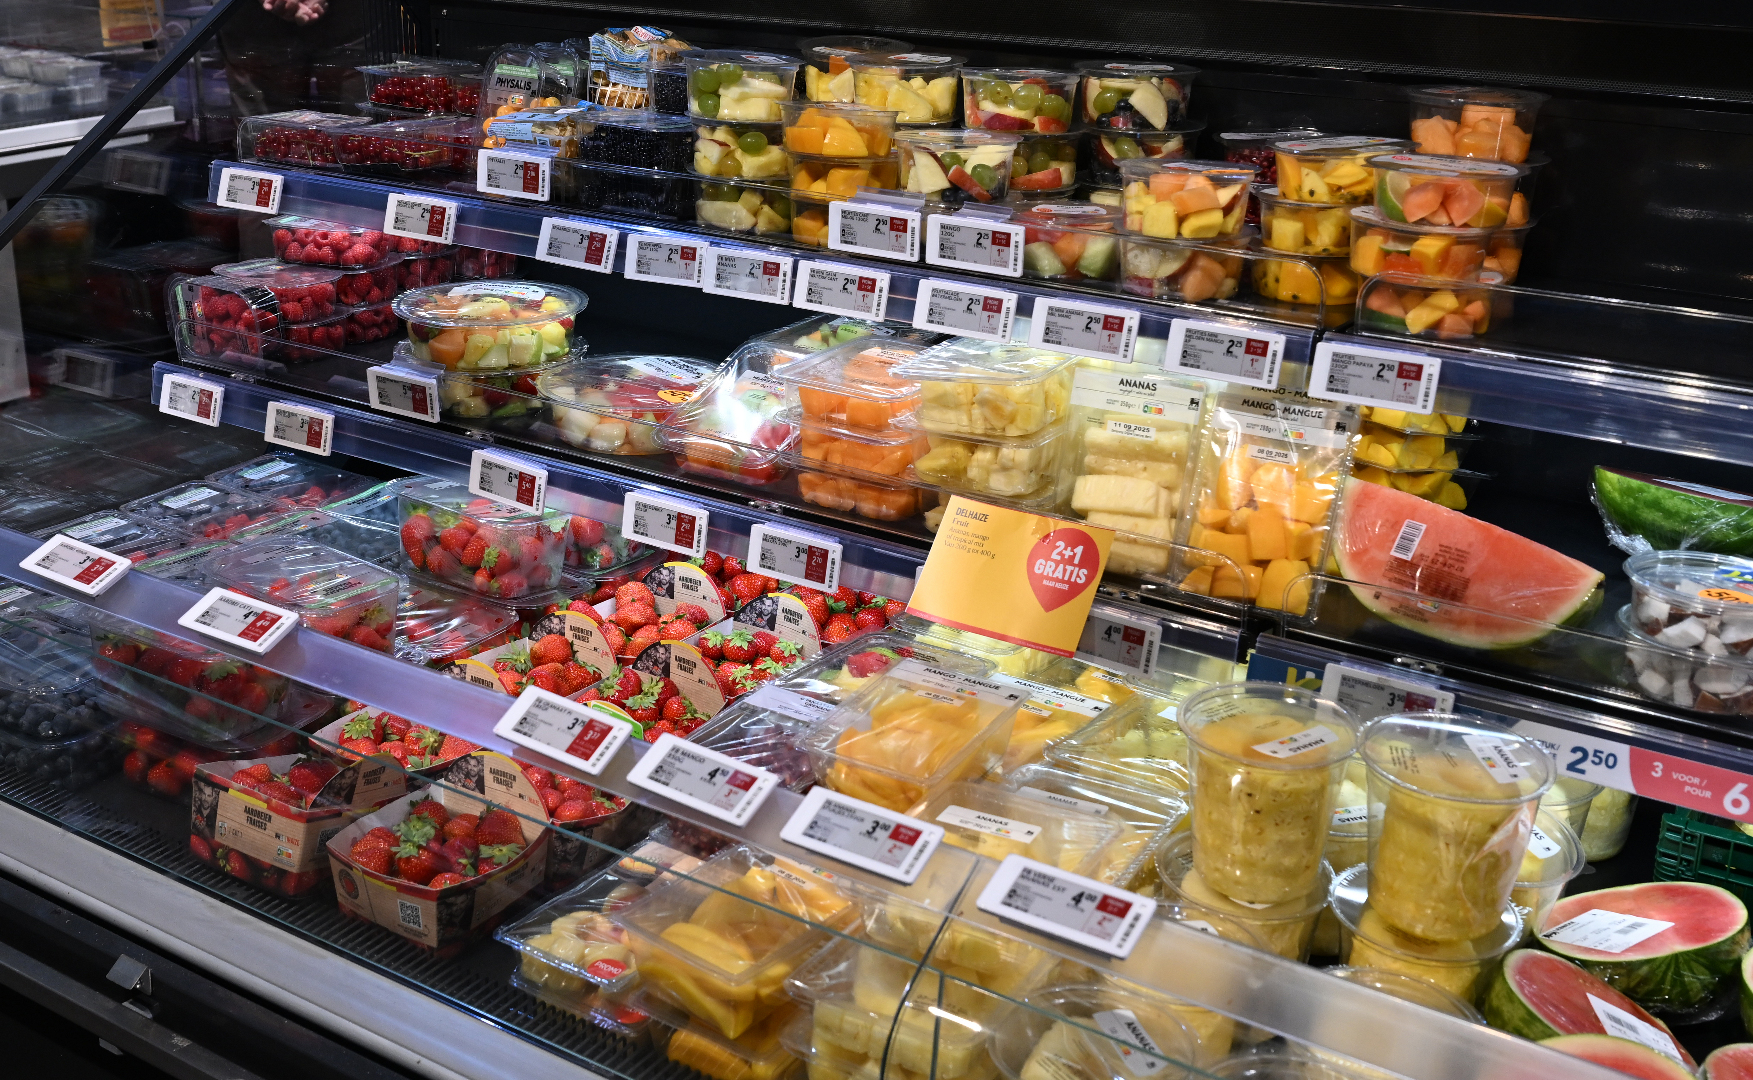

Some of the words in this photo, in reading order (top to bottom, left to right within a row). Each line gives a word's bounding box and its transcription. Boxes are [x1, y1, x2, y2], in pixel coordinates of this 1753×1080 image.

[495, 77, 532, 90] PHYSALIS
[1118, 378, 1158, 392] ANANAS
[1241, 398, 1276, 411] MANGO
[1283, 405, 1324, 419] MANGUE
[1133, 425, 1151, 433] 2025
[1274, 451, 1289, 459] 2025
[952, 516, 970, 528] Fruit
[955, 507, 989, 523] DELHAIZE
[953, 533, 973, 546] tropical
[970, 530, 990, 542] mango
[954, 541, 967, 551] 200
[980, 548, 991, 557] 400
[1051, 540, 1084, 565] 2+1
[1034, 558, 1088, 584] GRATIS
[678, 575, 702, 587] AARDBEIEN
[681, 582, 699, 593] FRAISES
[783, 614, 800, 626] FRAISES
[569, 624, 593, 638] AARDBEIEN
[572, 632, 590, 643] FRAISES
[674, 654, 697, 669] AARDBEIEN
[677, 662, 694, 675] FRAISES
[470, 674, 494, 689] AARDBEIEN
[923, 667, 956, 680] MANGO
[964, 676, 1002, 691] MANGUE
[1341, 675, 1385, 692] WATERMELOEN
[1341, 682, 1356, 690] STUK
[1014, 680, 1044, 693] MANGO
[1052, 689, 1086, 704] MANGUE
[1288, 738, 1326, 754] ANANAS
[680, 749, 706, 764] MANGO
[1492, 744, 1518, 769] ANANAS
[362, 766, 386, 779] AARDBEIEN
[489, 766, 517, 783] AARDBEIEN
[1651, 761, 1664, 778] 3
[1672, 771, 1701, 786] VOOR
[363, 776, 381, 787] FRAISES
[493, 775, 514, 789] FRAISES
[1684, 785, 1712, 799] POUR
[1722, 783, 1750, 815] 6
[1046, 795, 1079, 807] ANANAS
[244, 805, 273, 824] AARDBEIEN
[975, 814, 1010, 827] ANANAS
[246, 815, 267, 831] FRAISES
[594, 960, 622, 974] PROMO
[1124, 1021, 1155, 1053] ANANAS
